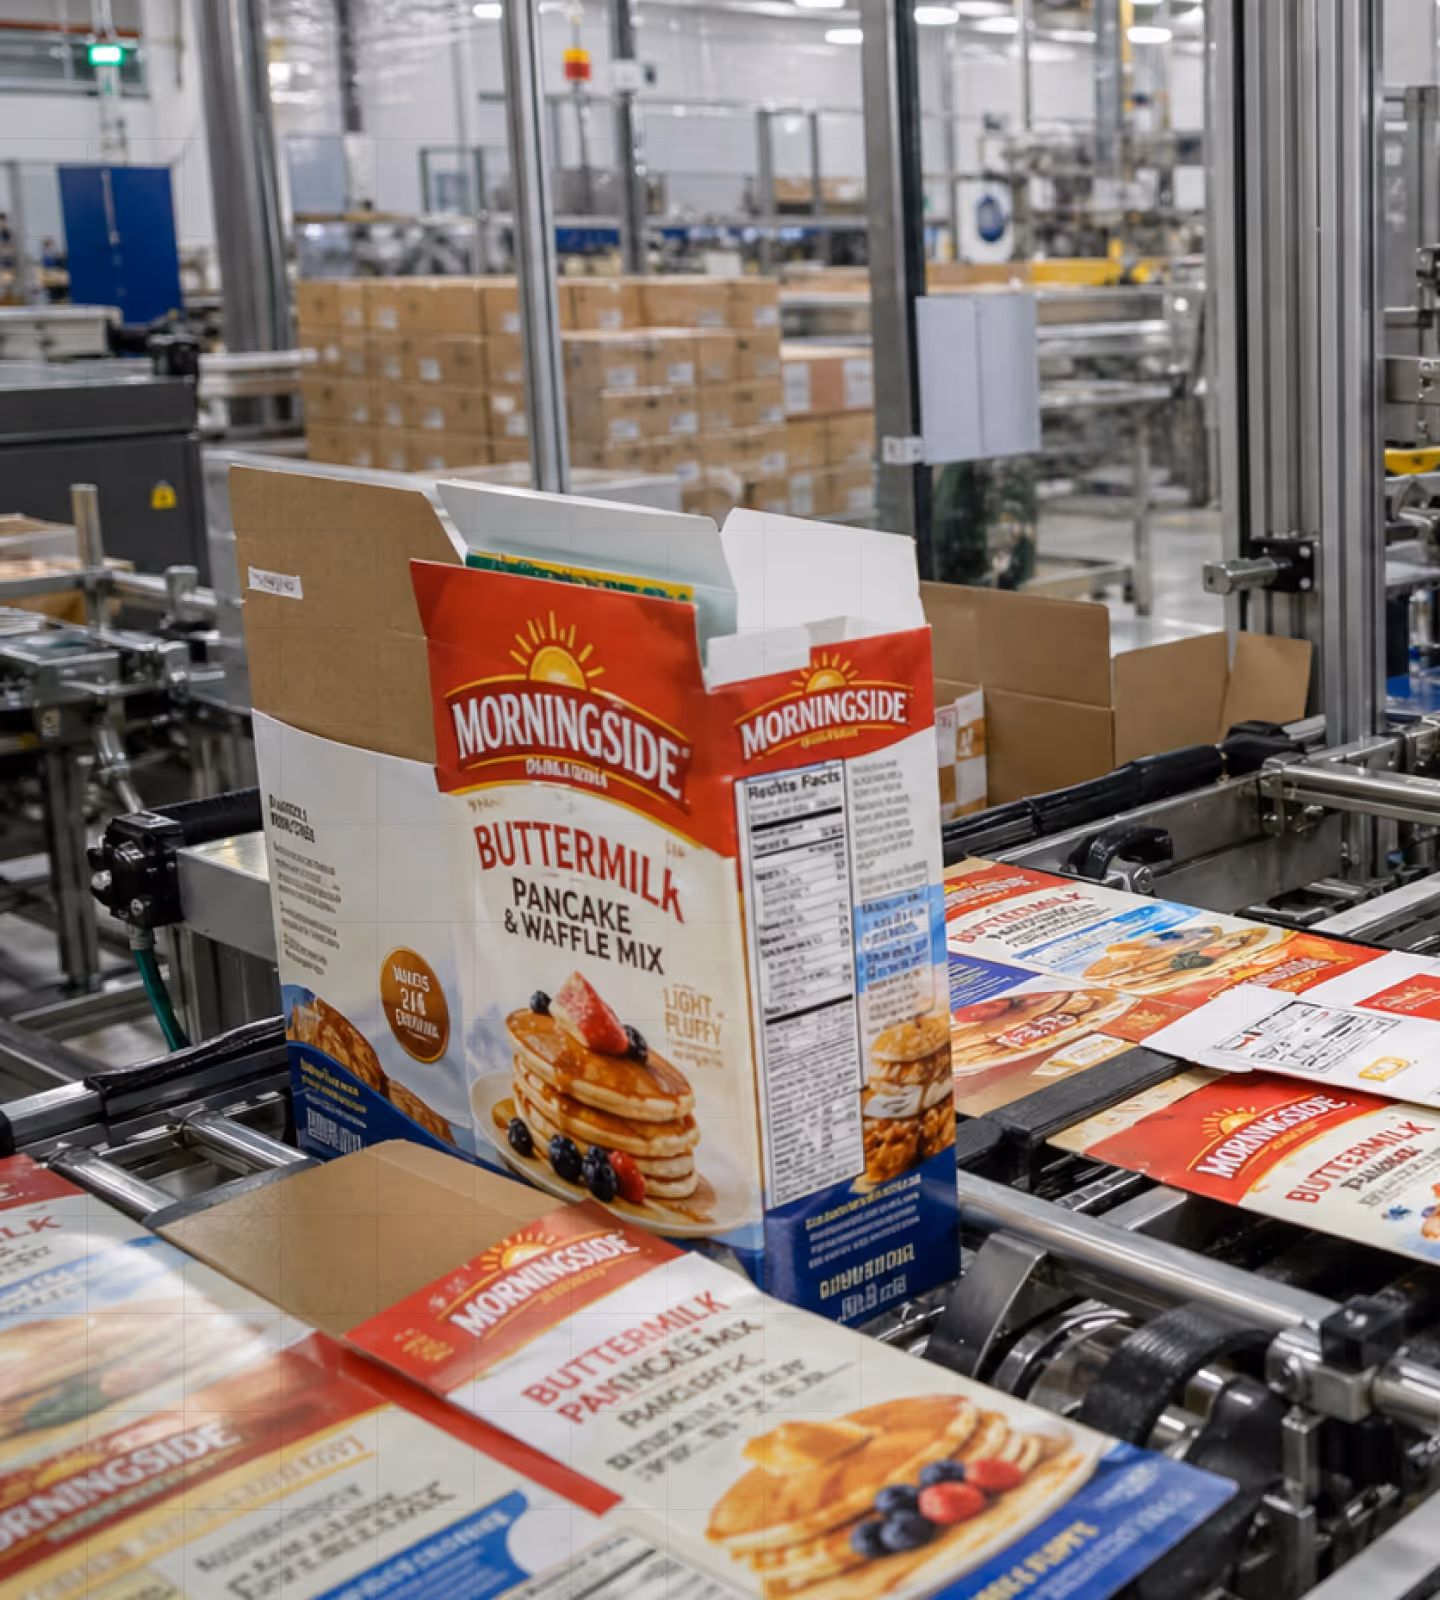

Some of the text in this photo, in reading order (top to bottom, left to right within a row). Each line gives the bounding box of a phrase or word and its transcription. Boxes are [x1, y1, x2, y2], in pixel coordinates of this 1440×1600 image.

[450, 693, 681, 799] MORNINGSIDE
[740, 691, 908, 760] MORNINGSIDE
[473, 820, 686, 923] BUTTERMILK
[512, 877, 632, 936] PANCAKE
[503, 907, 665, 976] & WAFFLE MIX
[450, 1231, 640, 1337] MORNINGSIDE
[0, 1421, 243, 1552] ORNINGSIDE
